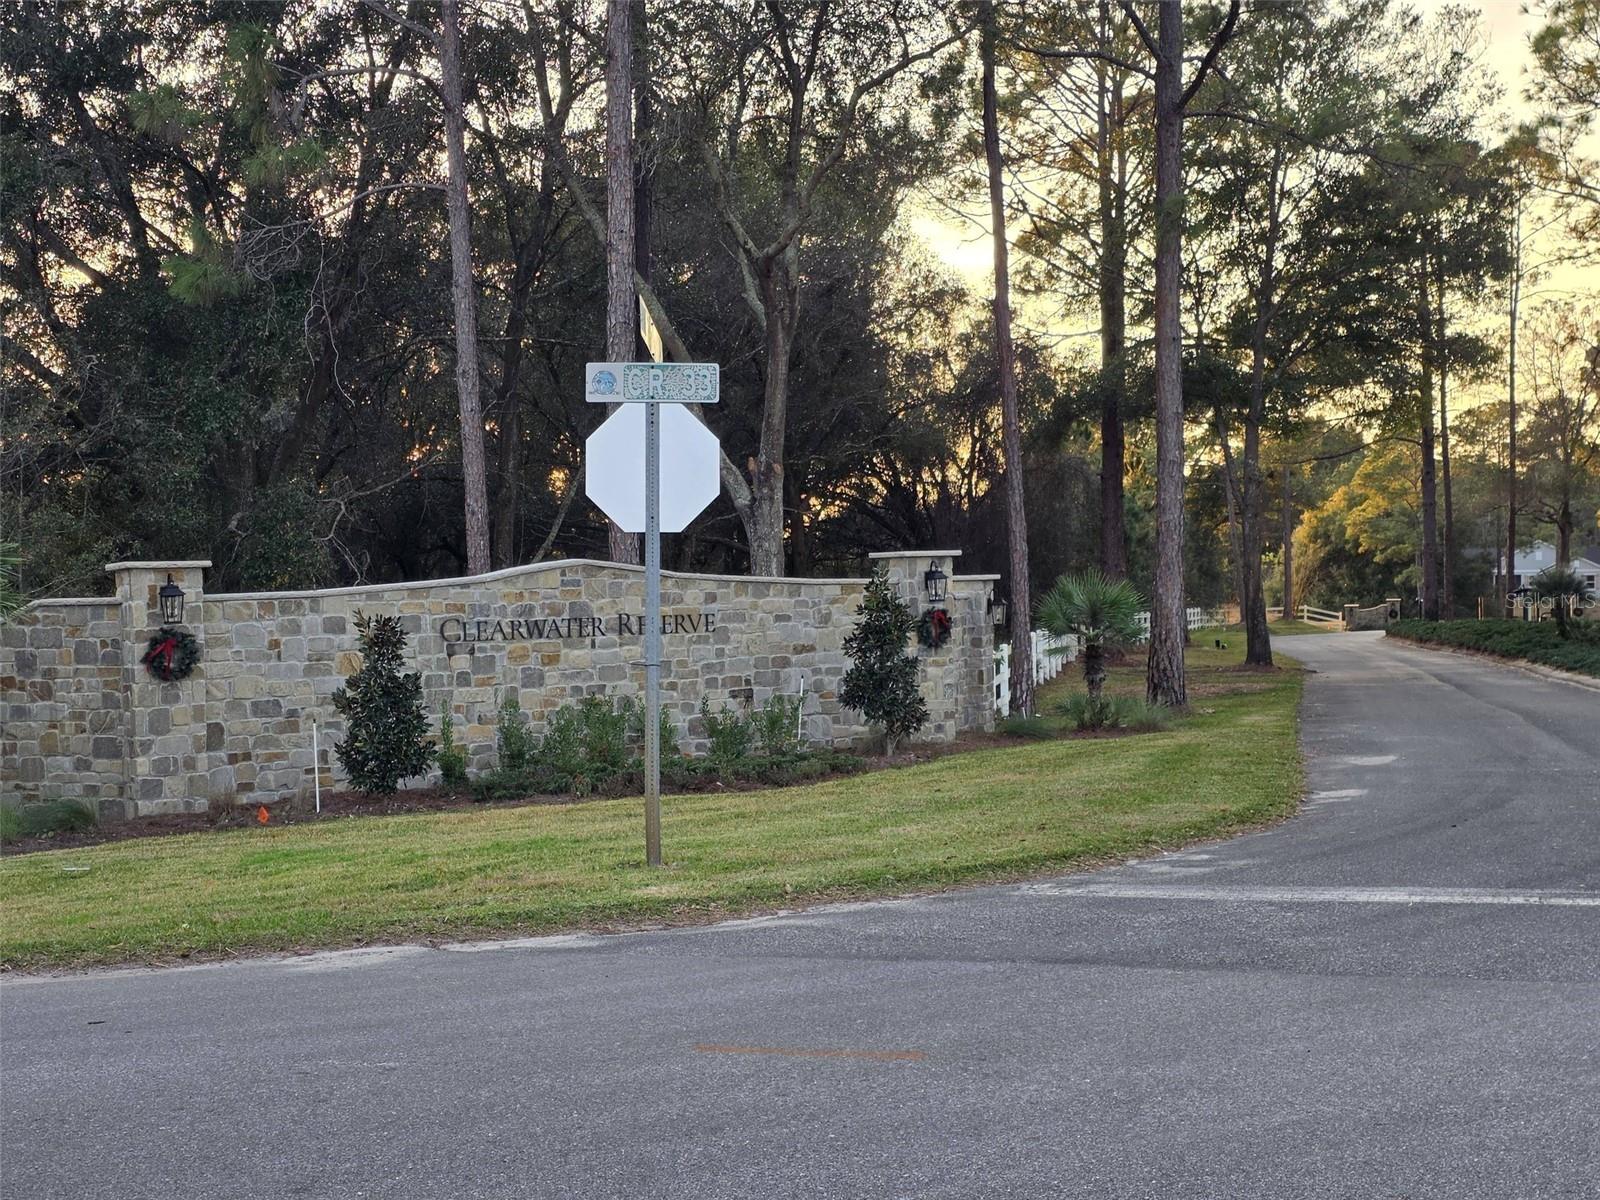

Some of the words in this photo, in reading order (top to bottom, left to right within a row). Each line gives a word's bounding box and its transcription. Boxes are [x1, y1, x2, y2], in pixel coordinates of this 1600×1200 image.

[628, 368, 664, 397] CR
[681, 368, 714, 397] 33
[440, 617, 606, 643] CLEARWATER
[618, 613, 716, 637] REERVE
